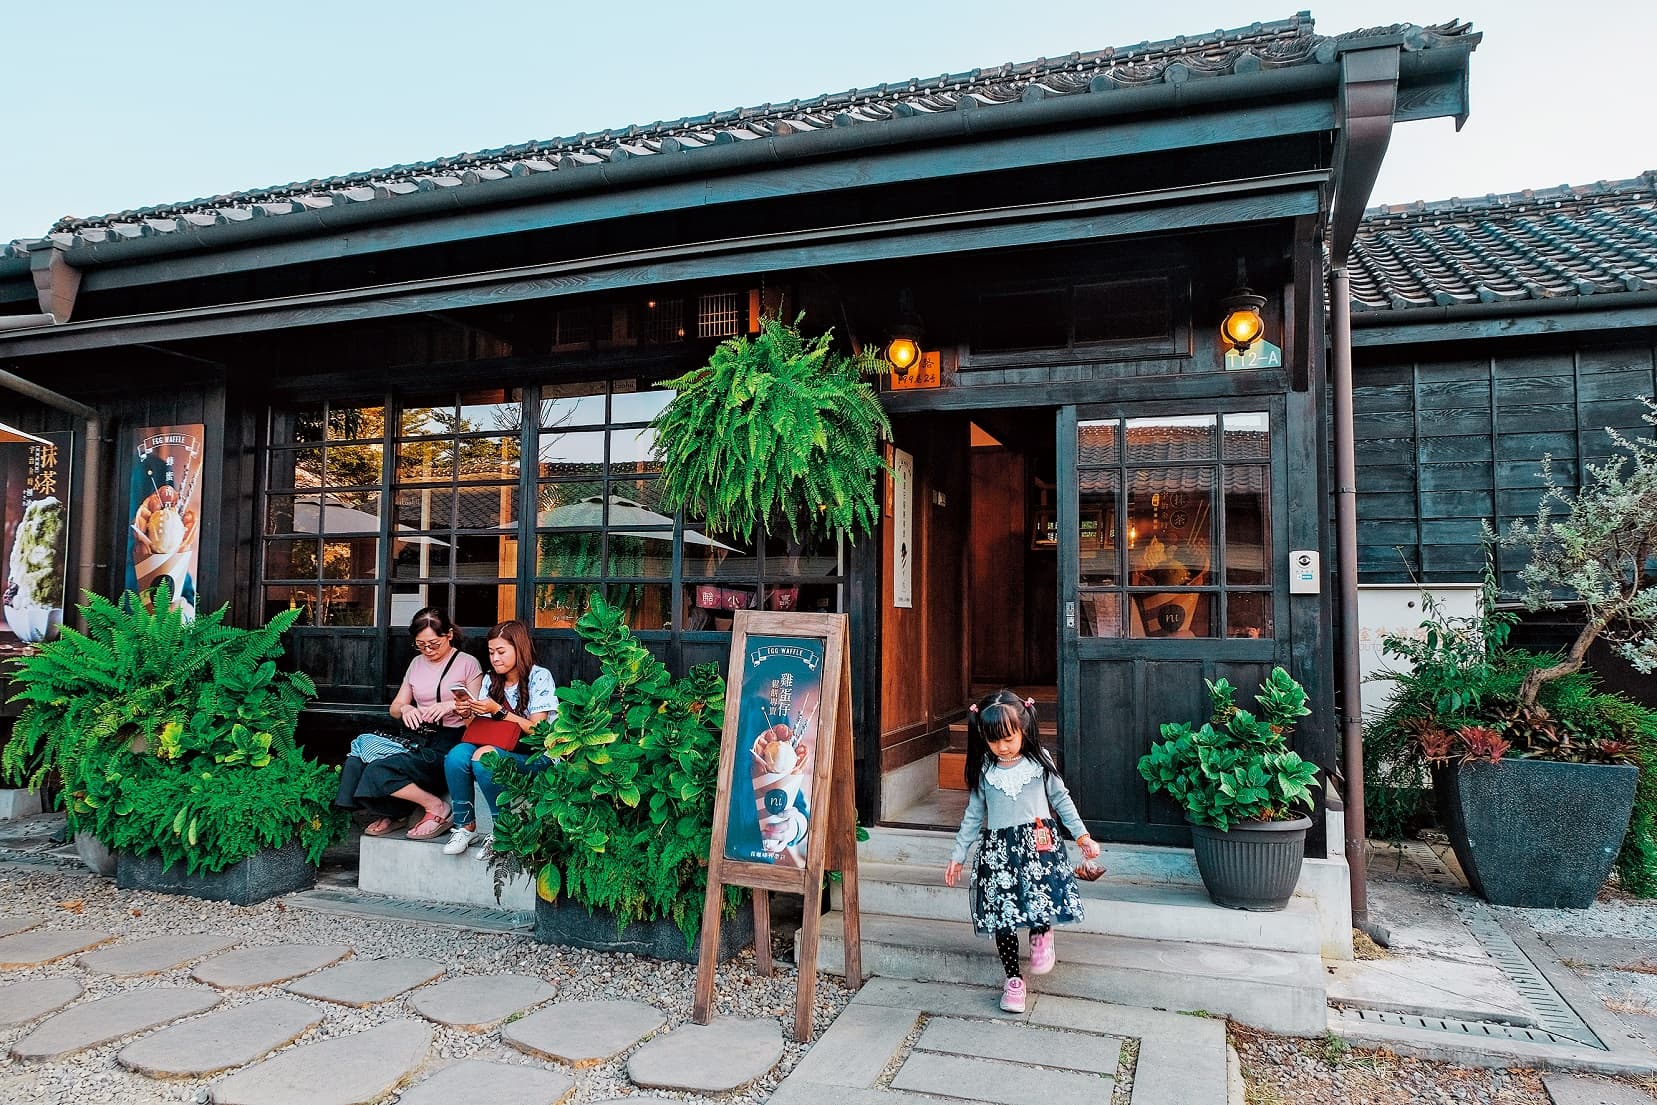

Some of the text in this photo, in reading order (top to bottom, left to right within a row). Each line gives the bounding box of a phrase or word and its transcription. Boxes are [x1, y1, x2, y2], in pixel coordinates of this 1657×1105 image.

[152, 436, 185, 445] EGG WAFFLE
[767, 647, 804, 657] EGG WAFFLE
[778, 673, 794, 717] 雞蛋仔
